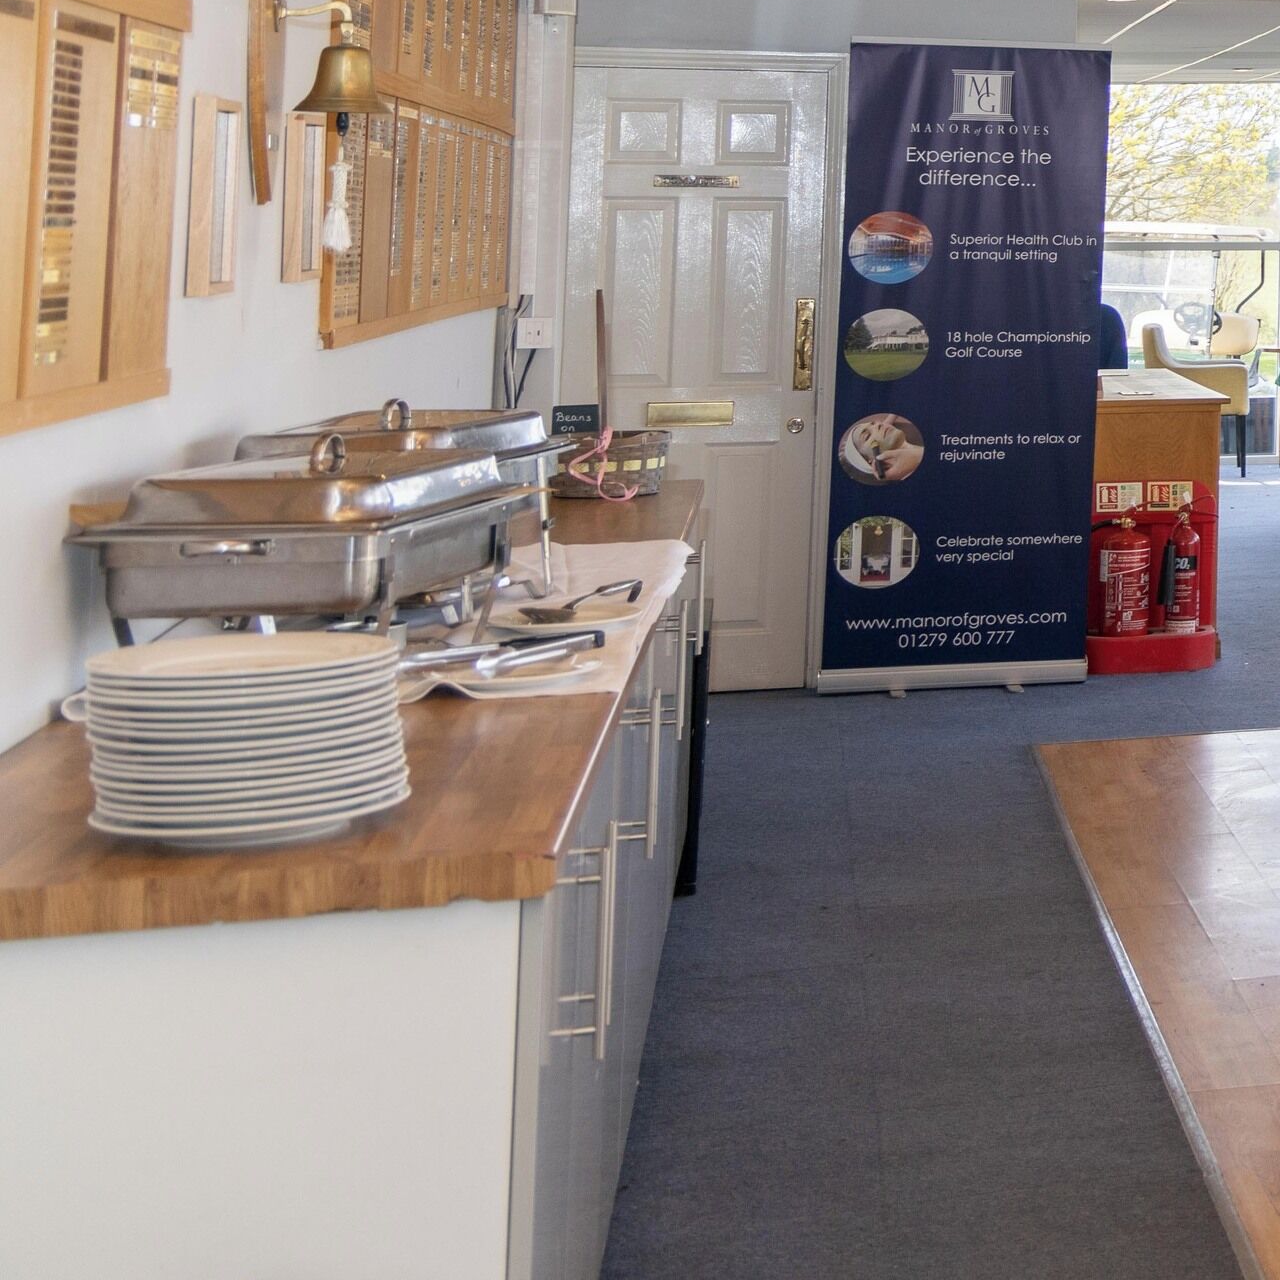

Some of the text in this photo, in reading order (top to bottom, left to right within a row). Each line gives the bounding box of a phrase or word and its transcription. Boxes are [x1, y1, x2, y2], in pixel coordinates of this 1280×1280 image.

[910, 122, 1050, 136] MANOR of GROVES
[906, 146, 1052, 166] Experience the
[919, 169, 1036, 187] difference...
[950, 234, 1097, 248] Superior Health Club in
[950, 249, 1058, 263] a tranquil setting
[946, 331, 1091, 345] 18 hole Championship
[945, 346, 1022, 359] Golf Course
[555, 411, 592, 422] Beans
[940, 432, 1081, 446] Treatments to relax or
[940, 449, 1005, 463] rejuvinate
[936, 533, 1083, 548] Celebrate somewhere
[936, 549, 1014, 564] very special
[846, 611, 1067, 630] www.manorofgroves.com
[899, 630, 1015, 648] 01279 600 777
